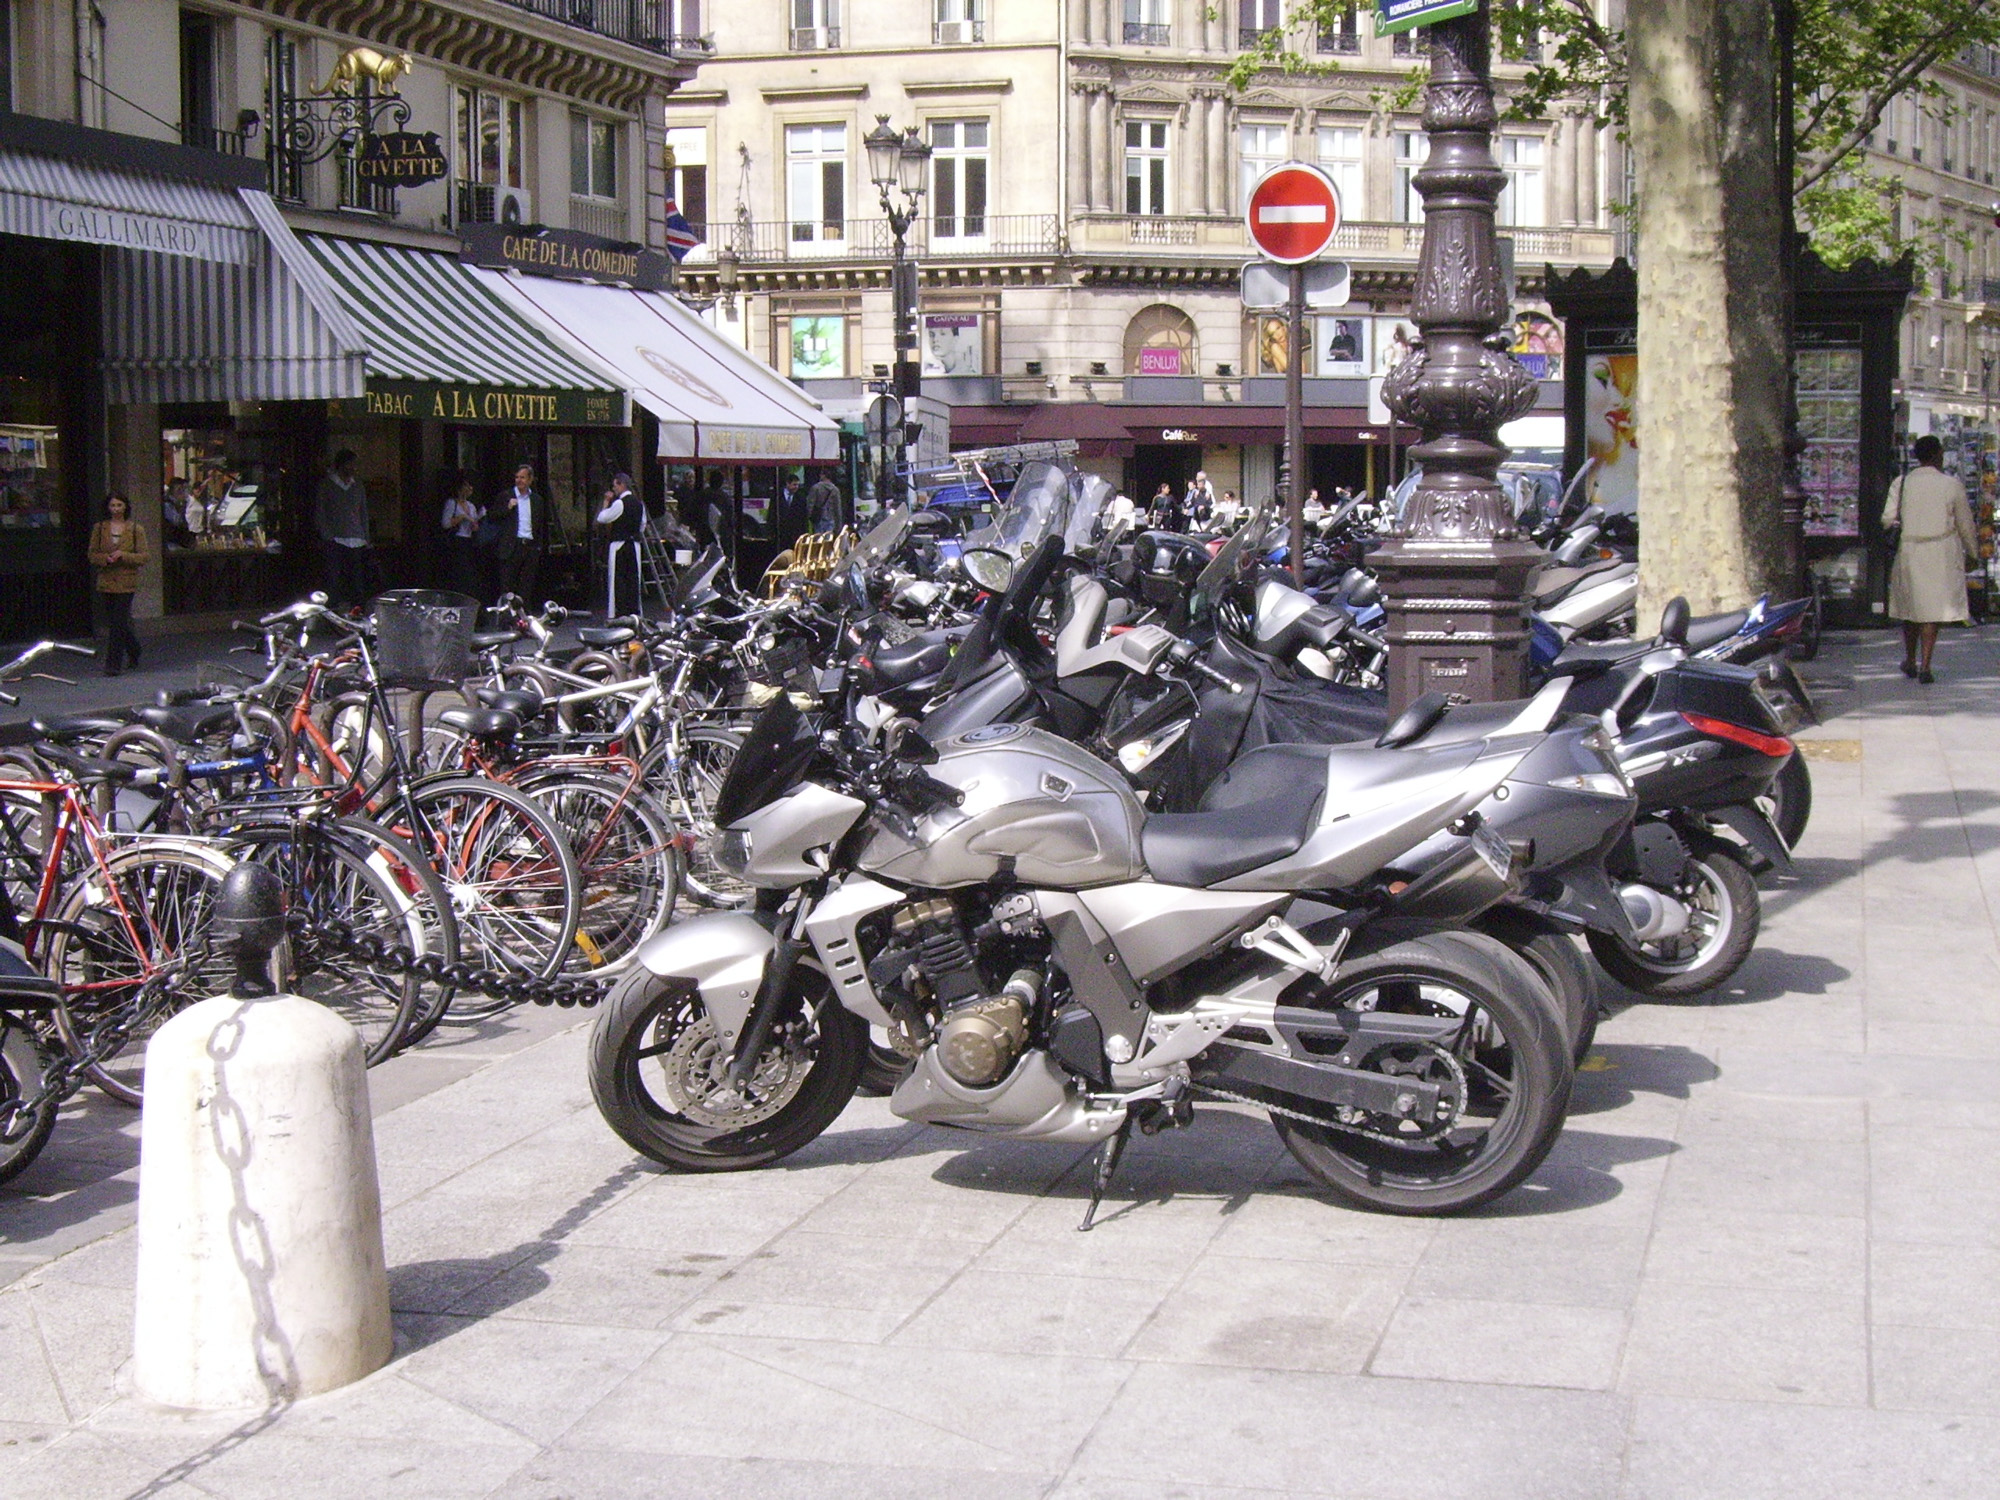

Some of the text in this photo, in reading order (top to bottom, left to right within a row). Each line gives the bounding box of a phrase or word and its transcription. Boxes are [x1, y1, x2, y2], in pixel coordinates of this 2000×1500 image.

[377, 139, 426, 156] A LA
[359, 158, 444, 177] CIVETTE
[58, 207, 197, 252] GALLIMARD
[503, 235, 639, 277] CAFE DE LA COMEDIE
[1143, 355, 1178, 370] BENLUX
[366, 390, 558, 421] TABAC A LA CIVETTE
